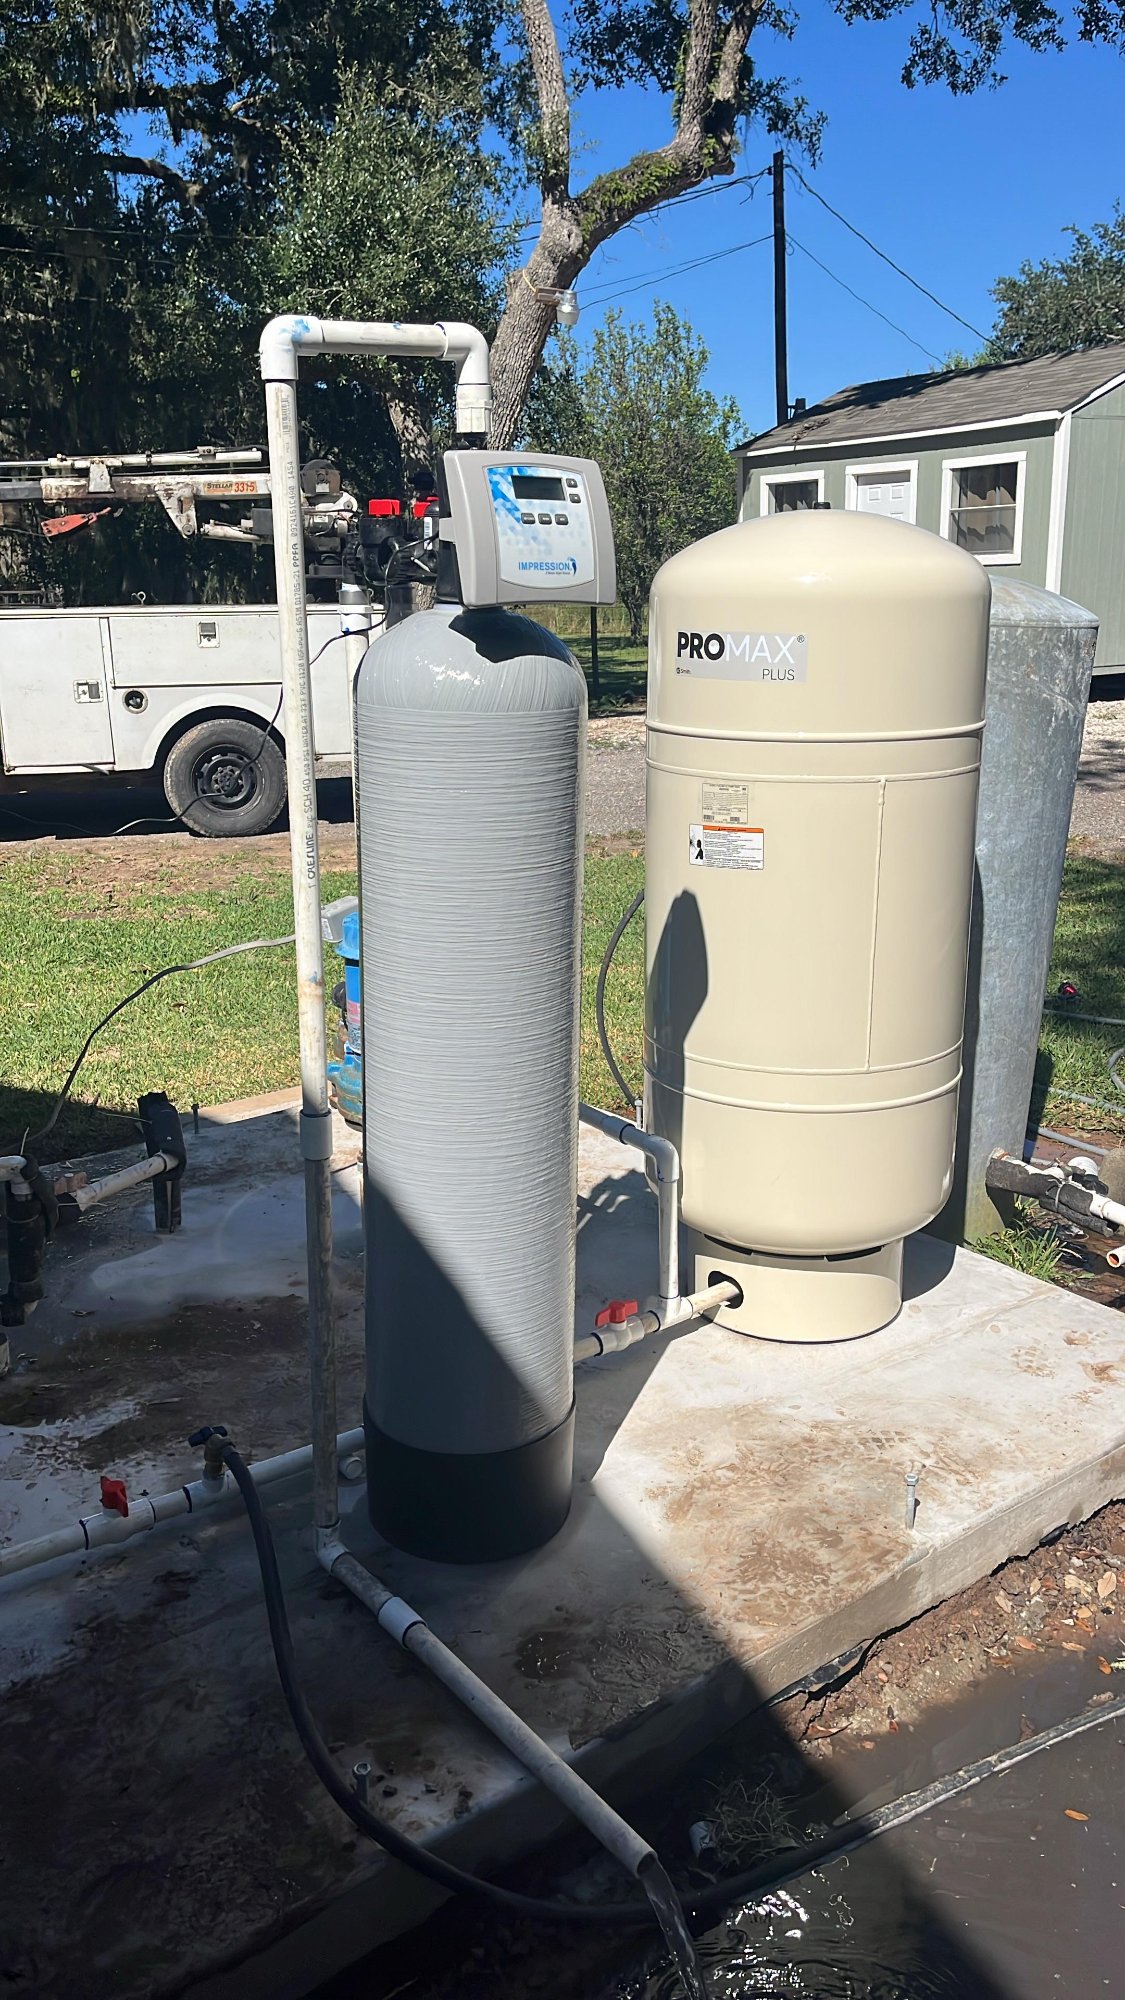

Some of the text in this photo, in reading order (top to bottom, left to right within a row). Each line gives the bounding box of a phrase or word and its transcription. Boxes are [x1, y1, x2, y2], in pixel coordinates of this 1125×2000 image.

[234, 482, 255, 493] 3315
[291, 543, 300, 568] PPFA
[518, 561, 570, 571] IMPRESSION
[295, 607, 303, 626] ASTM
[677, 631, 795, 664] PROMAX
[298, 662, 306, 680] 1120
[762, 668, 795, 681] PLUS
[298, 680, 306, 696] PVC
[301, 725, 309, 749] WATER
[302, 749, 310, 762] PSI
[302, 779, 311, 792] 40
[303, 793, 313, 814] SCH
[305, 833, 316, 880] CRESLINE
